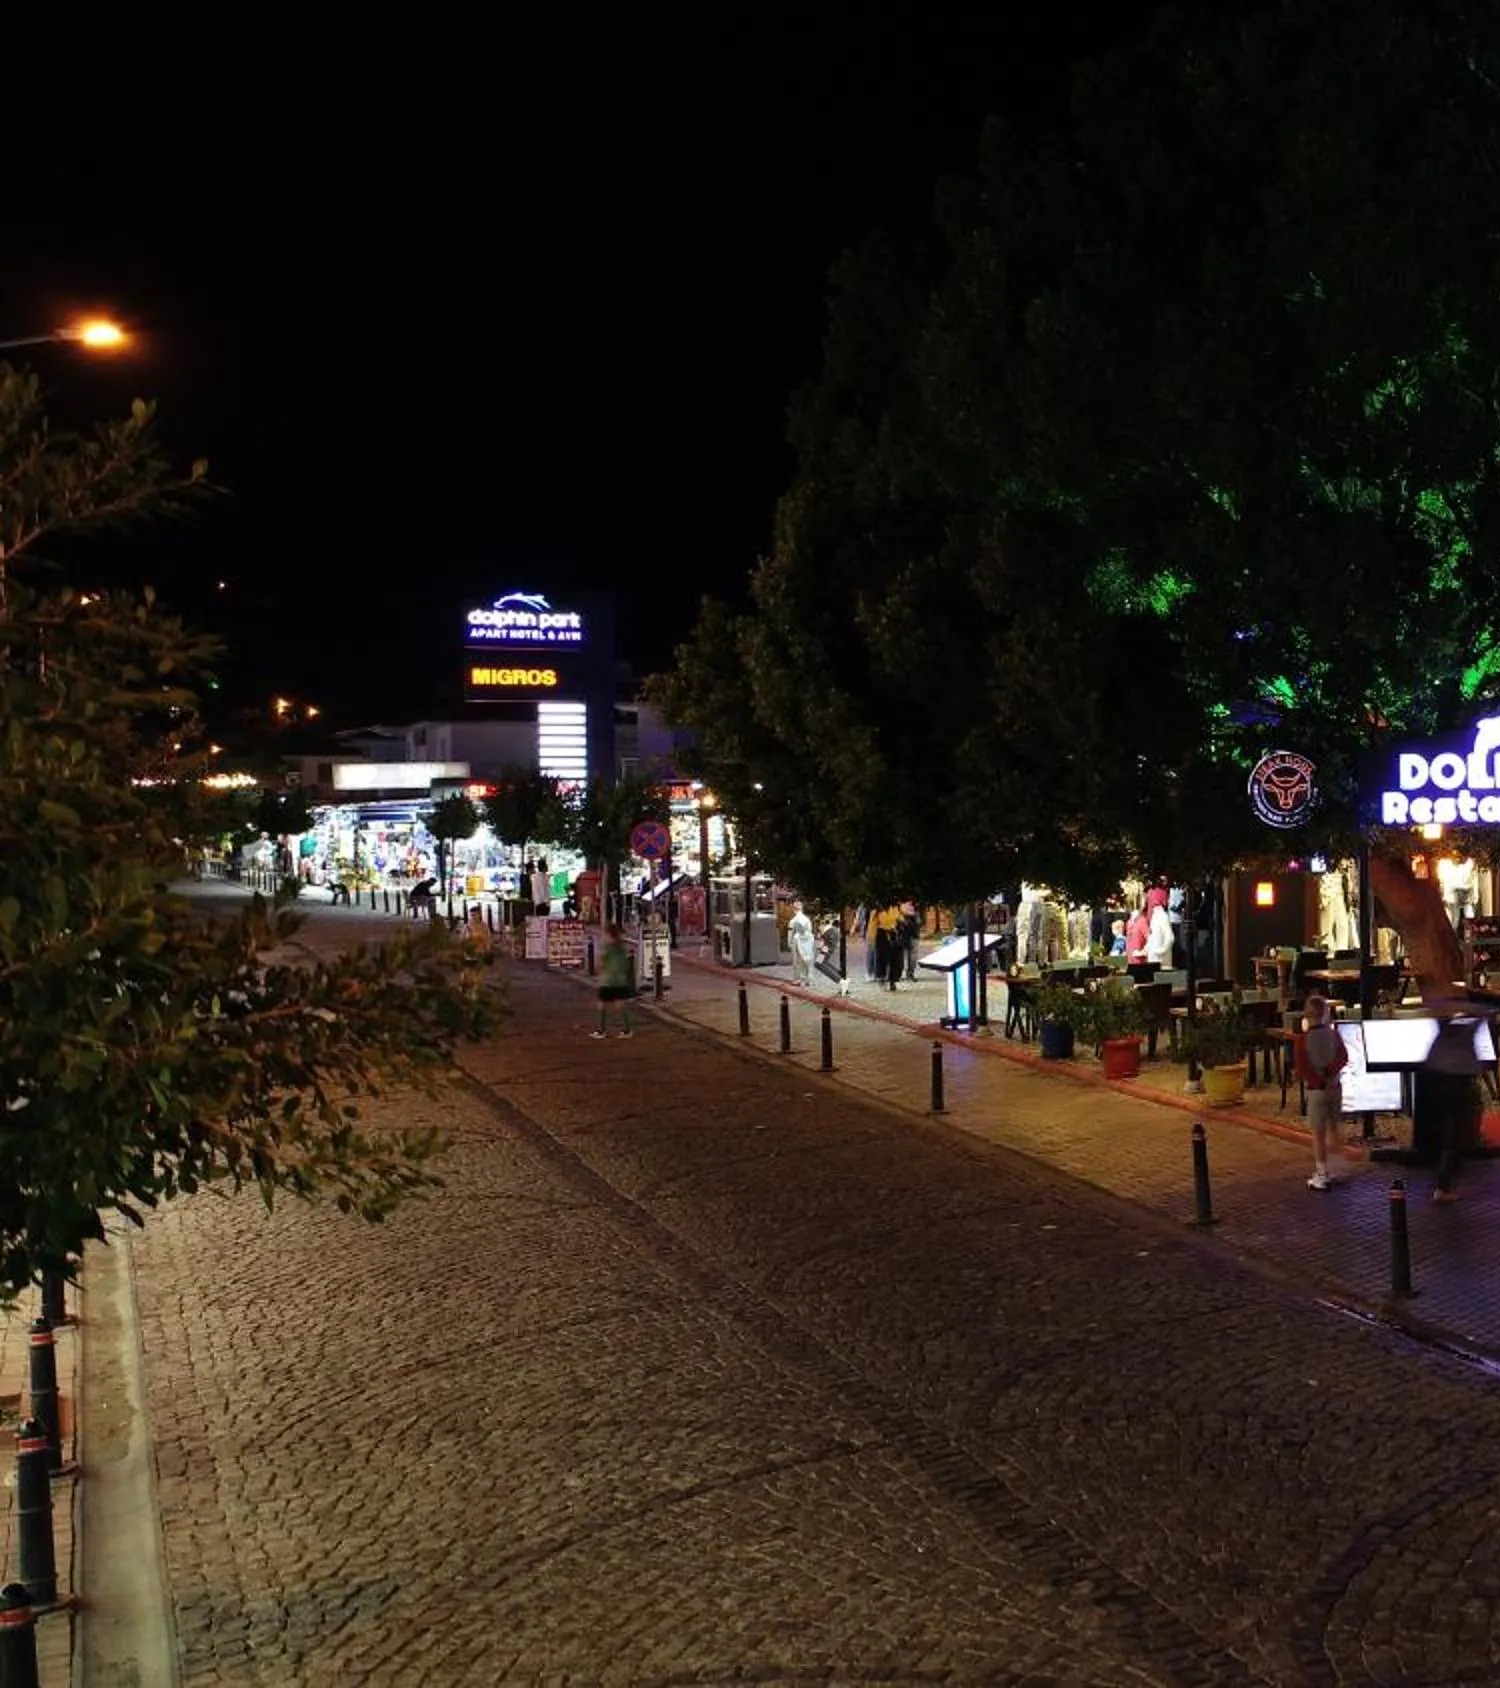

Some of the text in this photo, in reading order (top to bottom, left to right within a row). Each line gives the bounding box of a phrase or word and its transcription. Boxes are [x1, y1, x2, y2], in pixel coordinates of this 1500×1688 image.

[467, 608, 580, 629] dolphin park
[469, 627, 508, 639] APART
[509, 629, 546, 640] HOTEL
[471, 667, 557, 686] MIGROS
